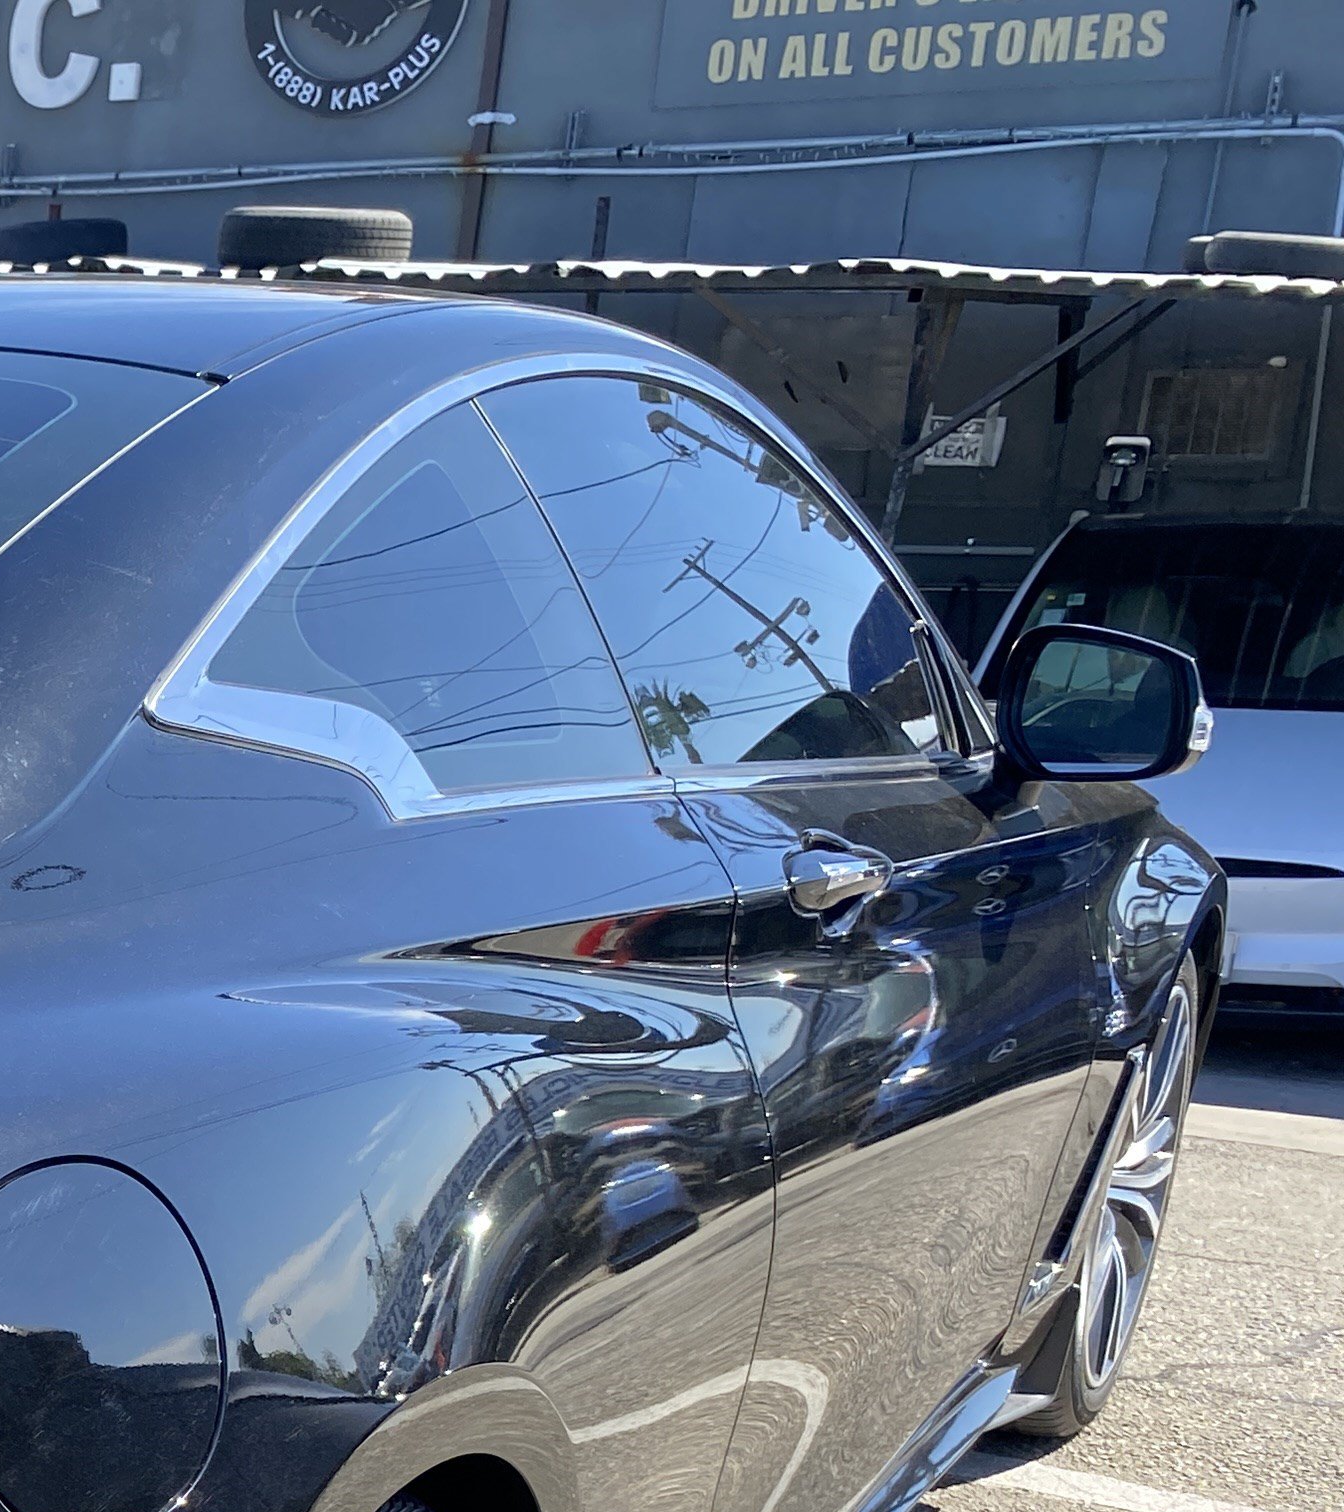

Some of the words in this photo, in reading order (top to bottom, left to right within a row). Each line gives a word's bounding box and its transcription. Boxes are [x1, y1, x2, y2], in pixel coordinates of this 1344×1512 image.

[257, 43, 322, 108] 1-(888)
[330, 33, 441, 110] KAR-PLUS
[708, 37, 767, 83] ON
[778, 32, 853, 79] ALL
[868, 10, 1168, 73] CUSTOMERS
